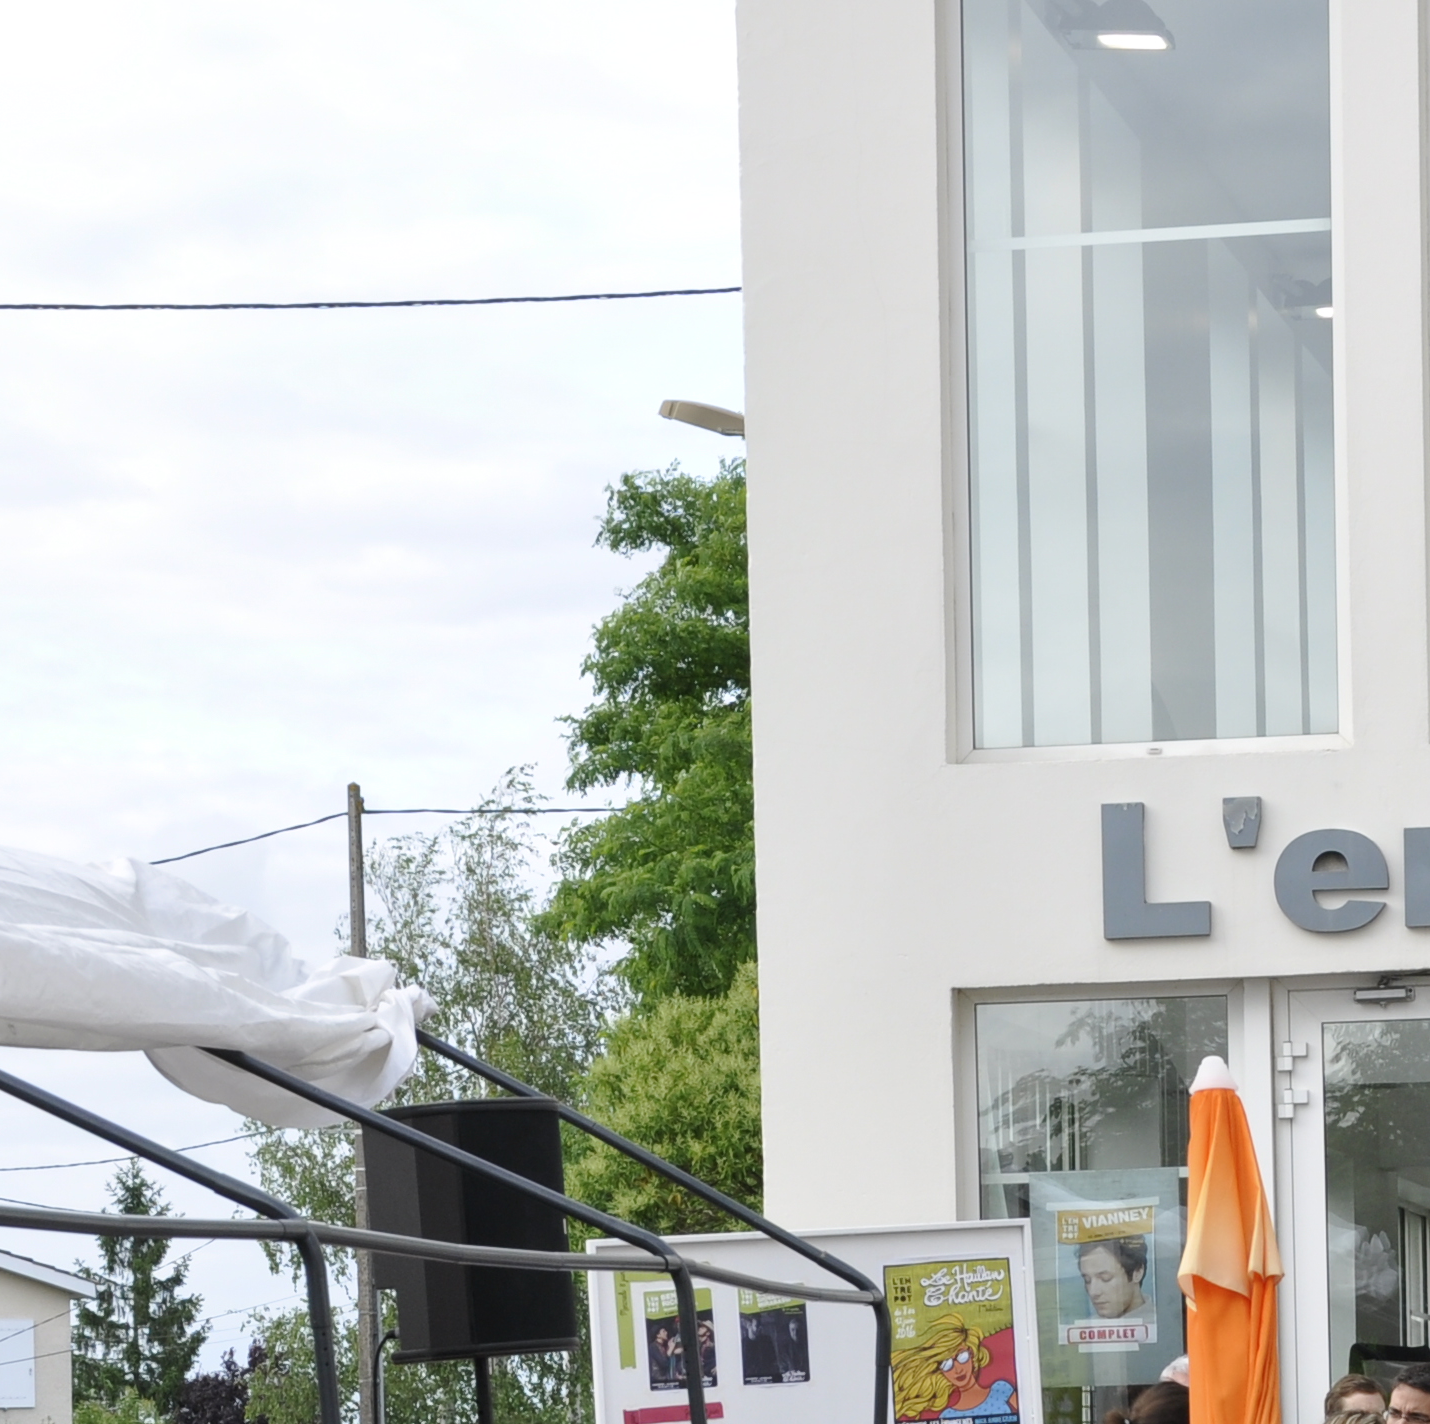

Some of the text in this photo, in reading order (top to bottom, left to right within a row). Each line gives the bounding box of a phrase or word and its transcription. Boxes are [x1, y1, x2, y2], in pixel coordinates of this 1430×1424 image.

[1082, 1207, 1149, 1229] VIANNEY
[952, 1263, 1005, 1291] Haillan
[923, 1281, 1004, 1307] Chanté
[1079, 1328, 1136, 1341] COMPLET
